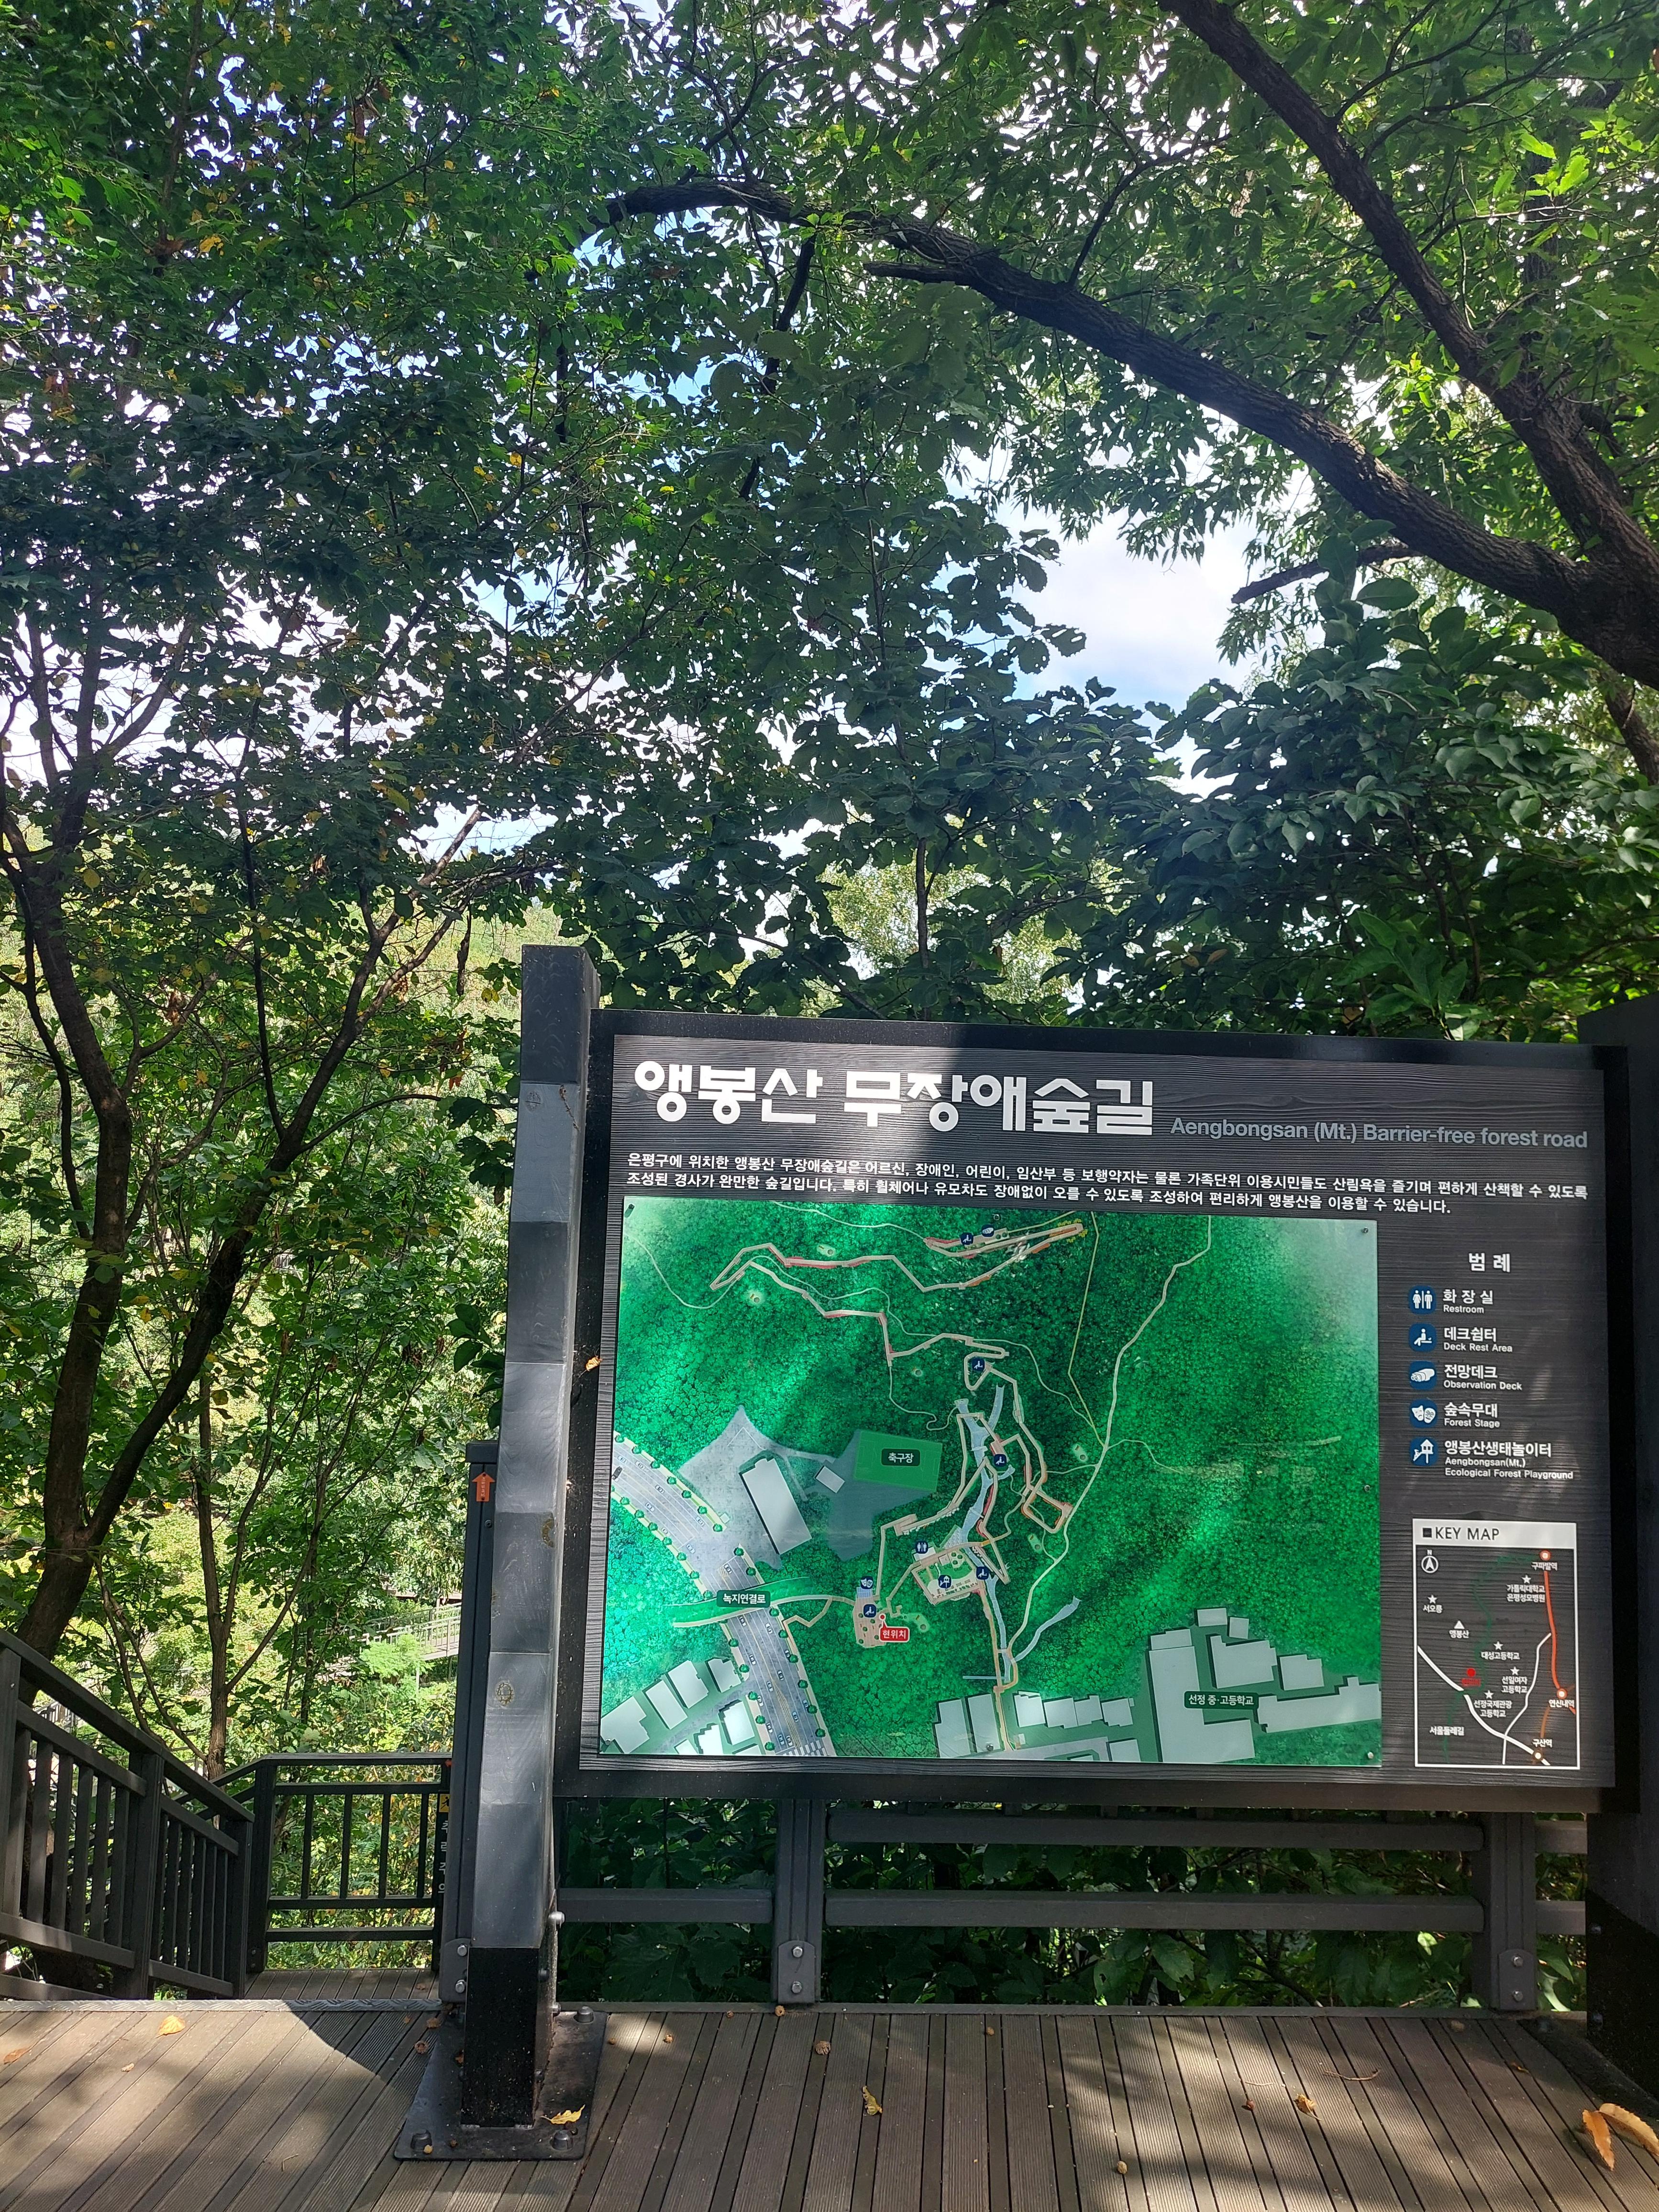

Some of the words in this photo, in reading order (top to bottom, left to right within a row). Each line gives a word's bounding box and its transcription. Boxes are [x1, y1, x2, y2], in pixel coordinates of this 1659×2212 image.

[635, 1061, 823, 1124] 앵봉산
[844, 1070, 1153, 1136] 무장애숲길
[1170, 1117, 1308, 1141] Aengbongsan
[1314, 1121, 1357, 1144] (Mt.)
[1363, 1124, 1475, 1144] Barrier-free
[1481, 1128, 1538, 1147] forest
[1544, 1131, 1588, 1148] road
[627, 1153, 682, 1168] 은평구에
[688, 1155, 729, 1170] 위치한
[734, 1156, 775, 1172] 앵봉산
[780, 1158, 862, 1174] 무장애숲길은
[865, 1160, 909, 1176] 어르신,
[915, 1162, 959, 1178] 장애인,
[966, 1164, 1010, 1180] 어린이,
[1017, 1166, 1056, 1181] 임산부
[1062, 1167, 1076, 1182] 등
[1081, 1169, 1149, 1184] 보행약자는
[1154, 1172, 1182, 1186] 물론
[1187, 1172, 1240, 1188] 가족단위
[1247, 1175, 1327, 1190] 이용시민들도
[1332, 1178, 1386, 1192] 산림욕을
[1392, 1180, 1431, 1194] 즐기며
[1438, 1182, 1478, 1196] 편하게
[1483, 1183, 1524, 1197] 산책할
[1528, 1184, 1543, 1198] 수
[1548, 1185, 1588, 1199] 있도록
[626, 1172, 668, 1186] 조성된
[674, 1173, 715, 1188] 경사가
[719, 1175, 760, 1190] 완만한
[765, 1176, 837, 1193] 숲길입니다.
[842, 1179, 869, 1194] 특히
[875, 1180, 929, 1195] 휠체어나
[934, 1183, 988, 1197] 유모차도
[994, 1184, 1047, 1199] 장애없이
[1052, 1186, 1080, 1200] 오를
[1085, 1187, 1099, 1202] 수
[1104, 1188, 1144, 1203] 있도록
[1149, 1190, 1203, 1205] 조성하여
[1209, 1193, 1262, 1207] 편리하게
[1268, 1194, 1322, 1209] 앵봉산을
[1328, 1196, 1368, 1211] 이용할
[1373, 1197, 1387, 1212] 수
[1393, 1198, 1451, 1214] 있습니다.
[1443, 1305, 1484, 1314] Restroom
[1444, 1327, 1497, 1342] 데크쉼터
[1443, 1342, 1466, 1351] Deck
[1470, 1343, 1489, 1352] Rest
[1492, 1344, 1513, 1352] Area
[1444, 1364, 1498, 1379] 전망데크
[1443, 1380, 1497, 1389] Observation
[1500, 1382, 1523, 1391] Deck
[1444, 1402, 1498, 1418] 숲속무대
[1444, 1418, 1471, 1427] Forest
[1474, 1419, 1500, 1428] Stage
[1445, 1440, 1551, 1458] 앵봉산생태놀이터
[887, 1451, 914, 1464] 축구장
[1445, 1457, 1526, 1468] Aengbongsan(Mt.)
[1445, 1469, 1491, 1478] Ecological
[1494, 1469, 1521, 1478] Forest
[1524, 1470, 1574, 1480] Playground
[1435, 1527, 1461, 1539] KEY
[1467, 1527, 1500, 1540] MAP
[722, 1592, 766, 1605] 녹지연결로
[882, 1629, 907, 1639] 현위치
[1481, 1652, 1520, 1660] 대성고등학교
[1502, 1676, 1528, 1685] 선일여자
[1501, 1685, 1528, 1693] 고등학교
[1189, 1694, 1206, 1705] 선정
[1208, 1695, 1254, 1706] 중·고등학교
[1474, 1700, 1512, 1709] 선정국제관광
[1549, 1699, 1575, 1708] 연신내역
[1480, 1709, 1506, 1718] 고등학교
[1429, 1726, 1465, 1736] 서울둘레길
[1533, 1738, 1552, 1748] 구산역
